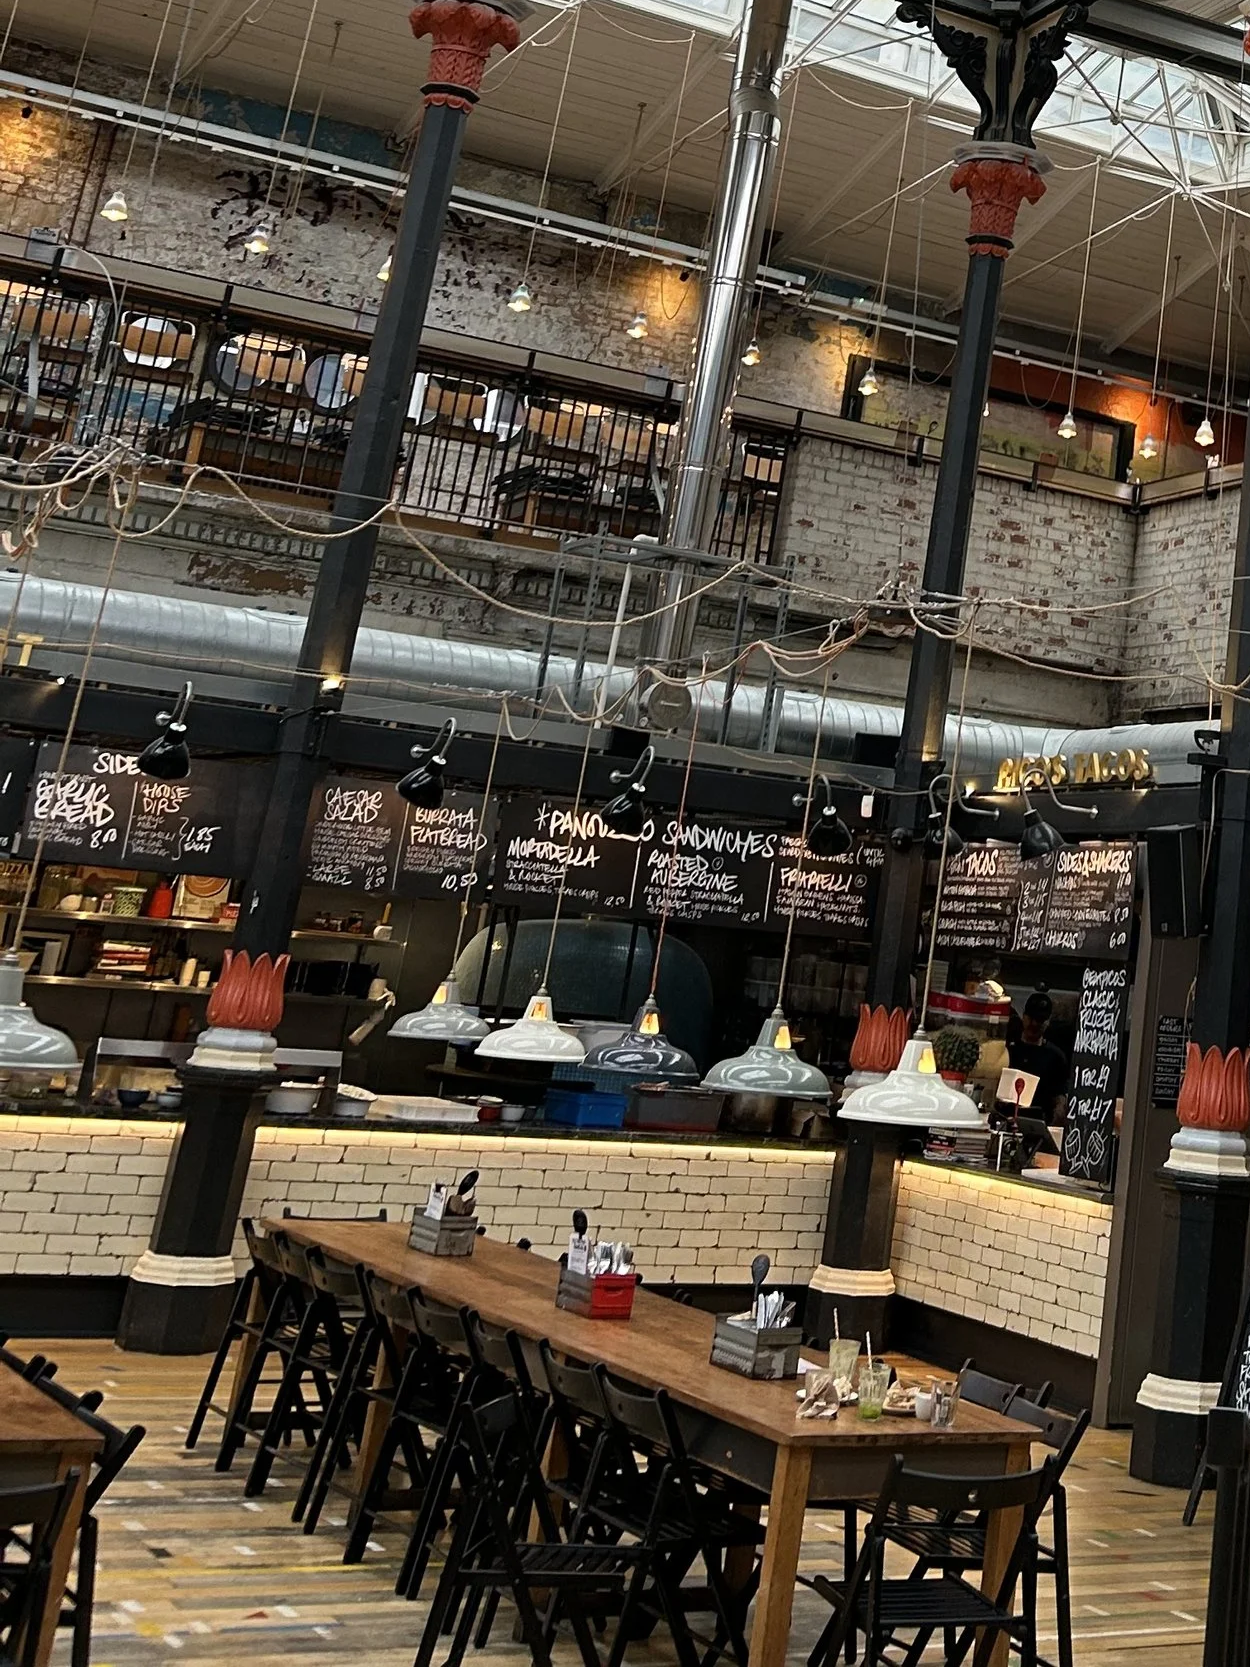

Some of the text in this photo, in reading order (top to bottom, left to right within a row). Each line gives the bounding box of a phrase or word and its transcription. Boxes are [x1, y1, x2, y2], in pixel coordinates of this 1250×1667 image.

[93, 752, 147, 775] SIDE
[1073, 748, 1153, 784] TACOS
[141, 782, 192, 799] HOUSE
[325, 786, 383, 809] CAESAR
[34, 796, 115, 827] BREAD
[143, 798, 184, 814] DIPS
[324, 803, 379, 823] SALAD
[414, 806, 479, 831] BURRATA
[410, 825, 488, 851] FLATBREAD
[661, 820, 778, 862] SANDWICHES
[506, 836, 600, 868] MORTADELLA
[647, 849, 708, 871] ROASTED
[966, 849, 999, 877] TACOS
[1057, 851, 1083, 874] SIDES
[312, 864, 351, 875] LARGE
[312, 873, 353, 885] SMALL
[650, 868, 738, 892] AUBERGINE
[1079, 1009, 1120, 1032] FROZEN
[1082, 1072, 1096, 1086] FOR
[1067, 1096, 1076, 1120] 2
[1078, 1099, 1090, 1116] FOR
